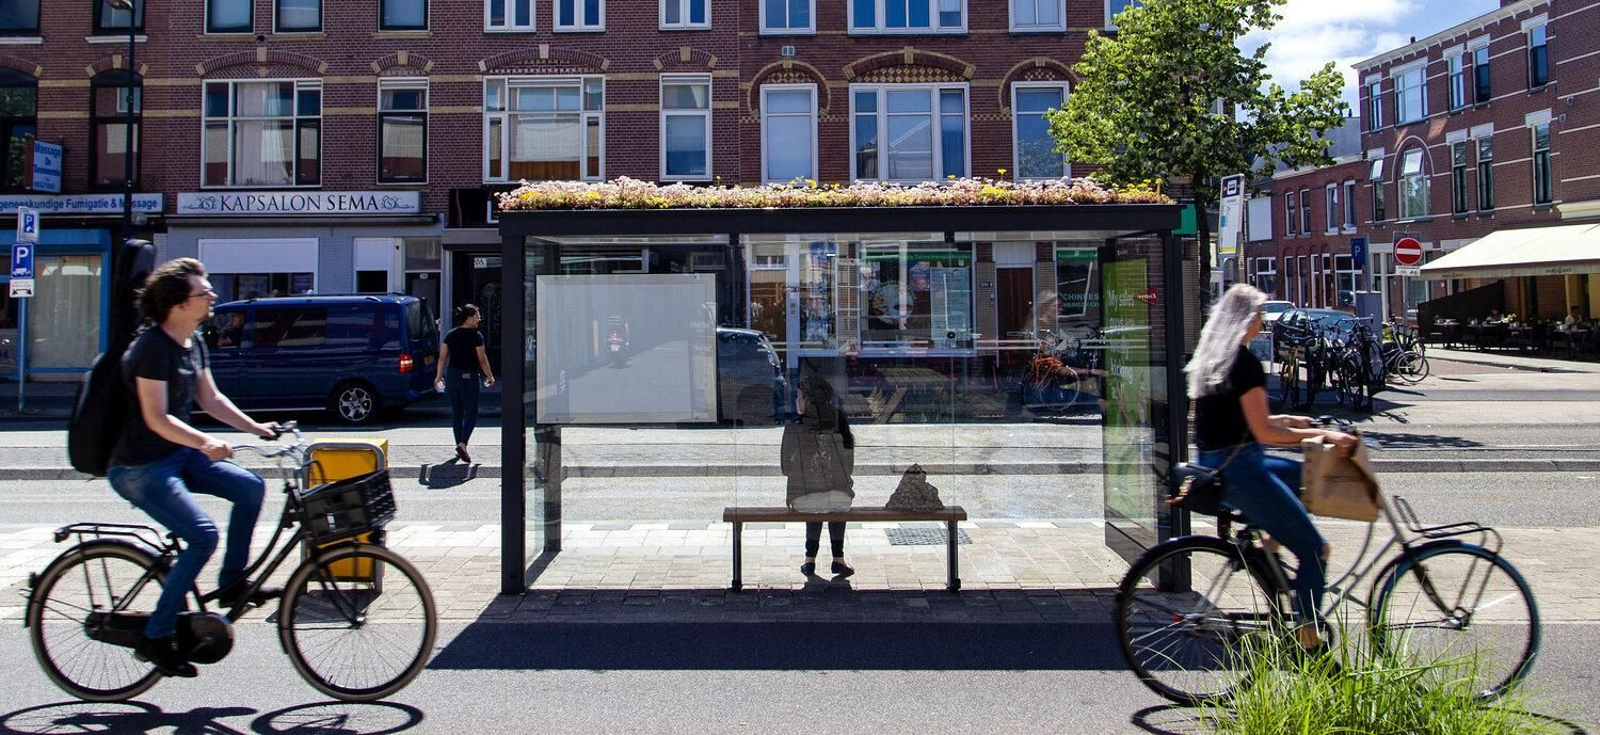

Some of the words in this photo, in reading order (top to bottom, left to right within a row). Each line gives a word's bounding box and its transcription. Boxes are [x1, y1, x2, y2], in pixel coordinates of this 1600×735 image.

[66, 198, 109, 211] Fumigatie
[110, 199, 118, 208] &
[119, 198, 158, 210] Mssage
[221, 194, 321, 211] KAPSALON
[326, 194, 380, 211] SEMA
[16, 246, 29, 264] P
[1355, 245, 1361, 256] P
